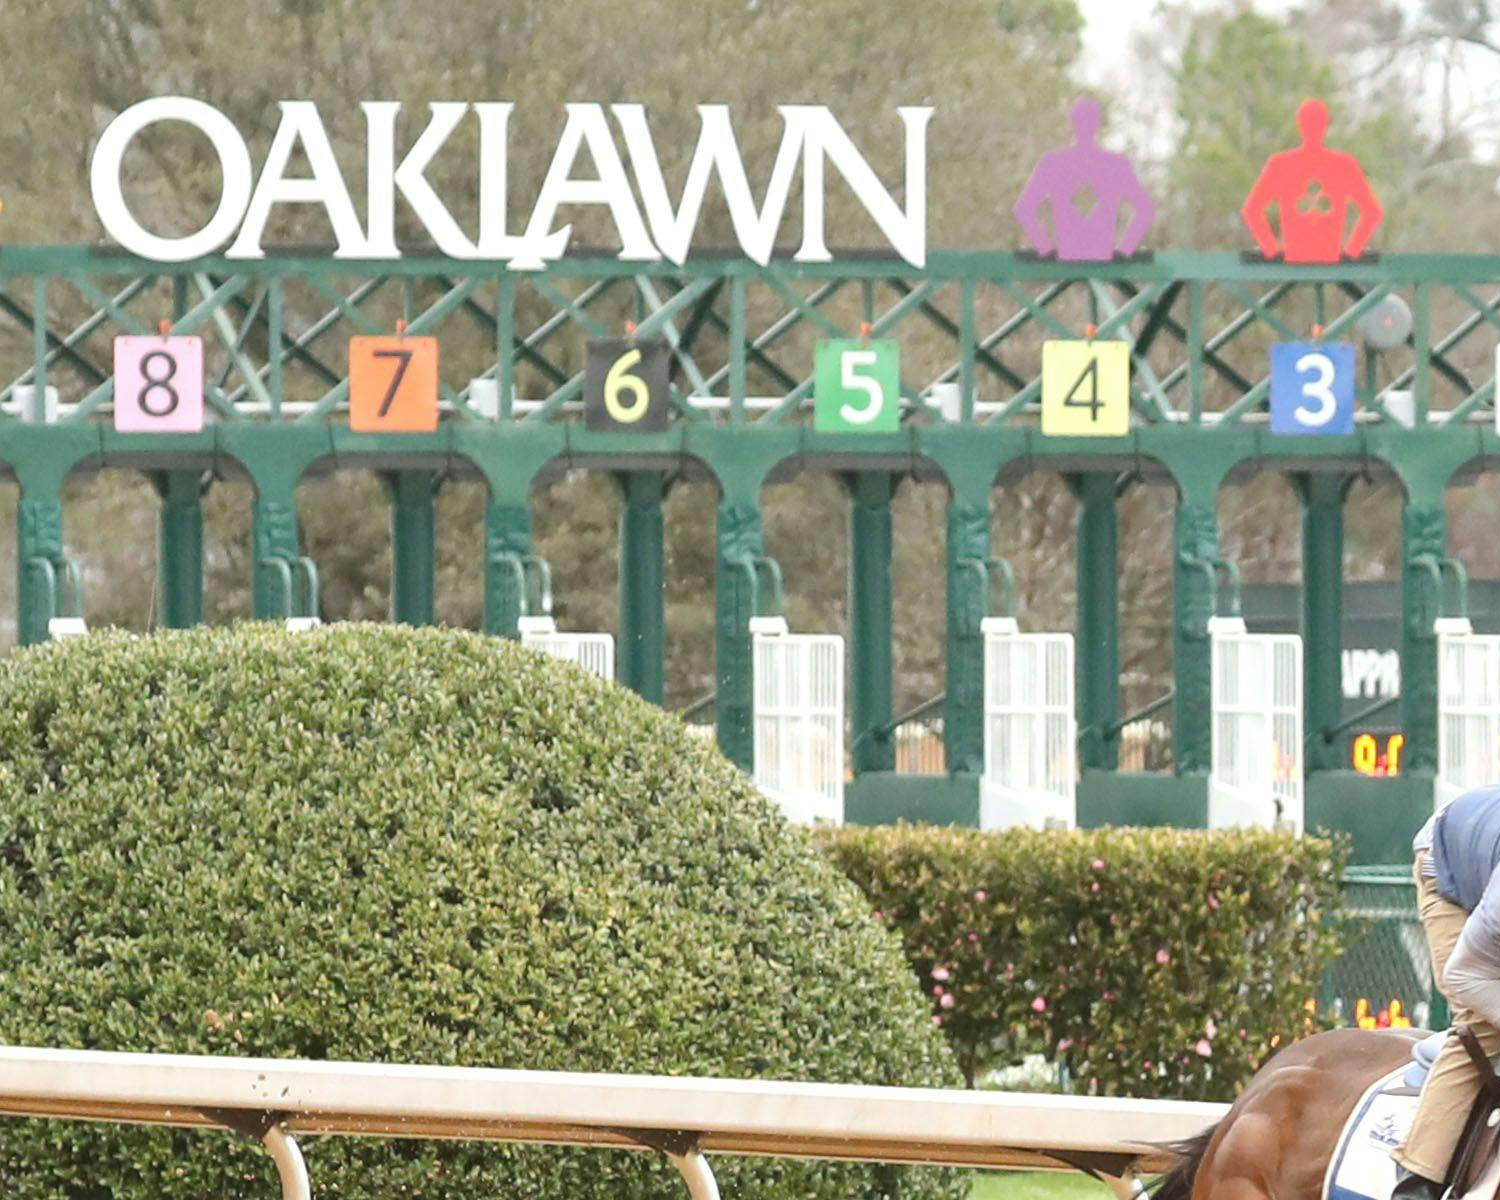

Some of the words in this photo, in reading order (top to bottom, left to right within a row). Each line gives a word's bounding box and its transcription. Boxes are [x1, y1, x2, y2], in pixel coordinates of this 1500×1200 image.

[91, 96, 935, 270] OAKLAWN
[137, 350, 180, 418] 8
[372, 350, 414, 418] 7
[603, 348, 650, 424] 6
[839, 350, 886, 425] 5
[1063, 358, 1106, 422] 4
[1292, 352, 1337, 427] 3
